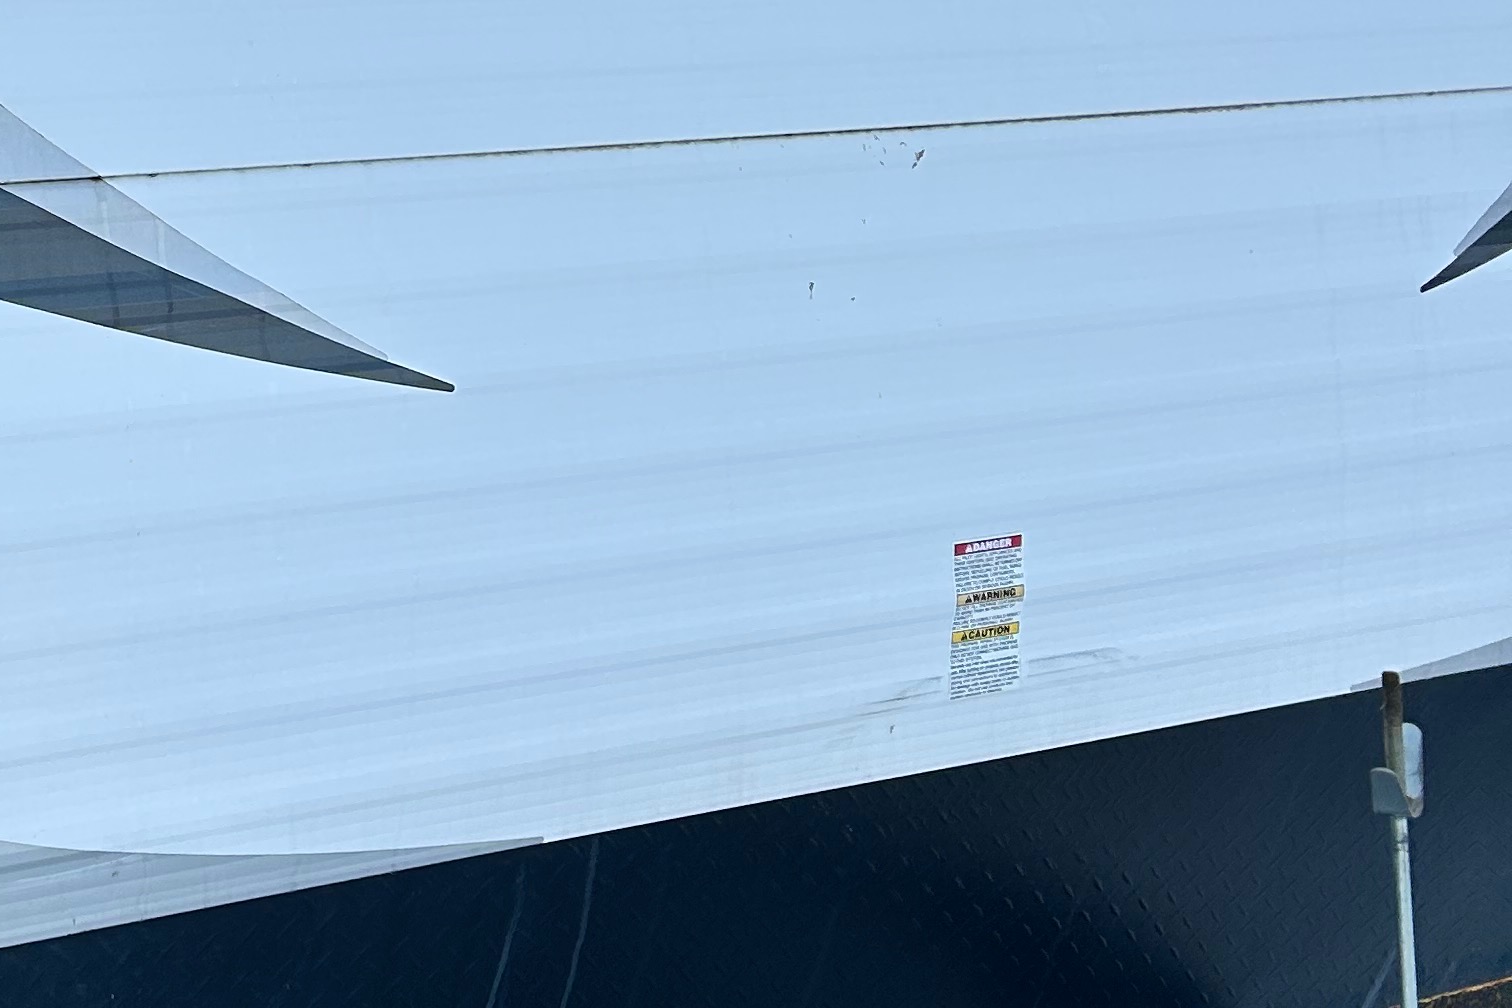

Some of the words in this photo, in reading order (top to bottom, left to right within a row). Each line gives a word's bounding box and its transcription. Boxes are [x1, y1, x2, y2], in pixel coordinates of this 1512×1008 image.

[973, 537, 1012, 552] DANGER
[973, 587, 1017, 602] WARNING
[968, 625, 1010, 640] CAUTION
